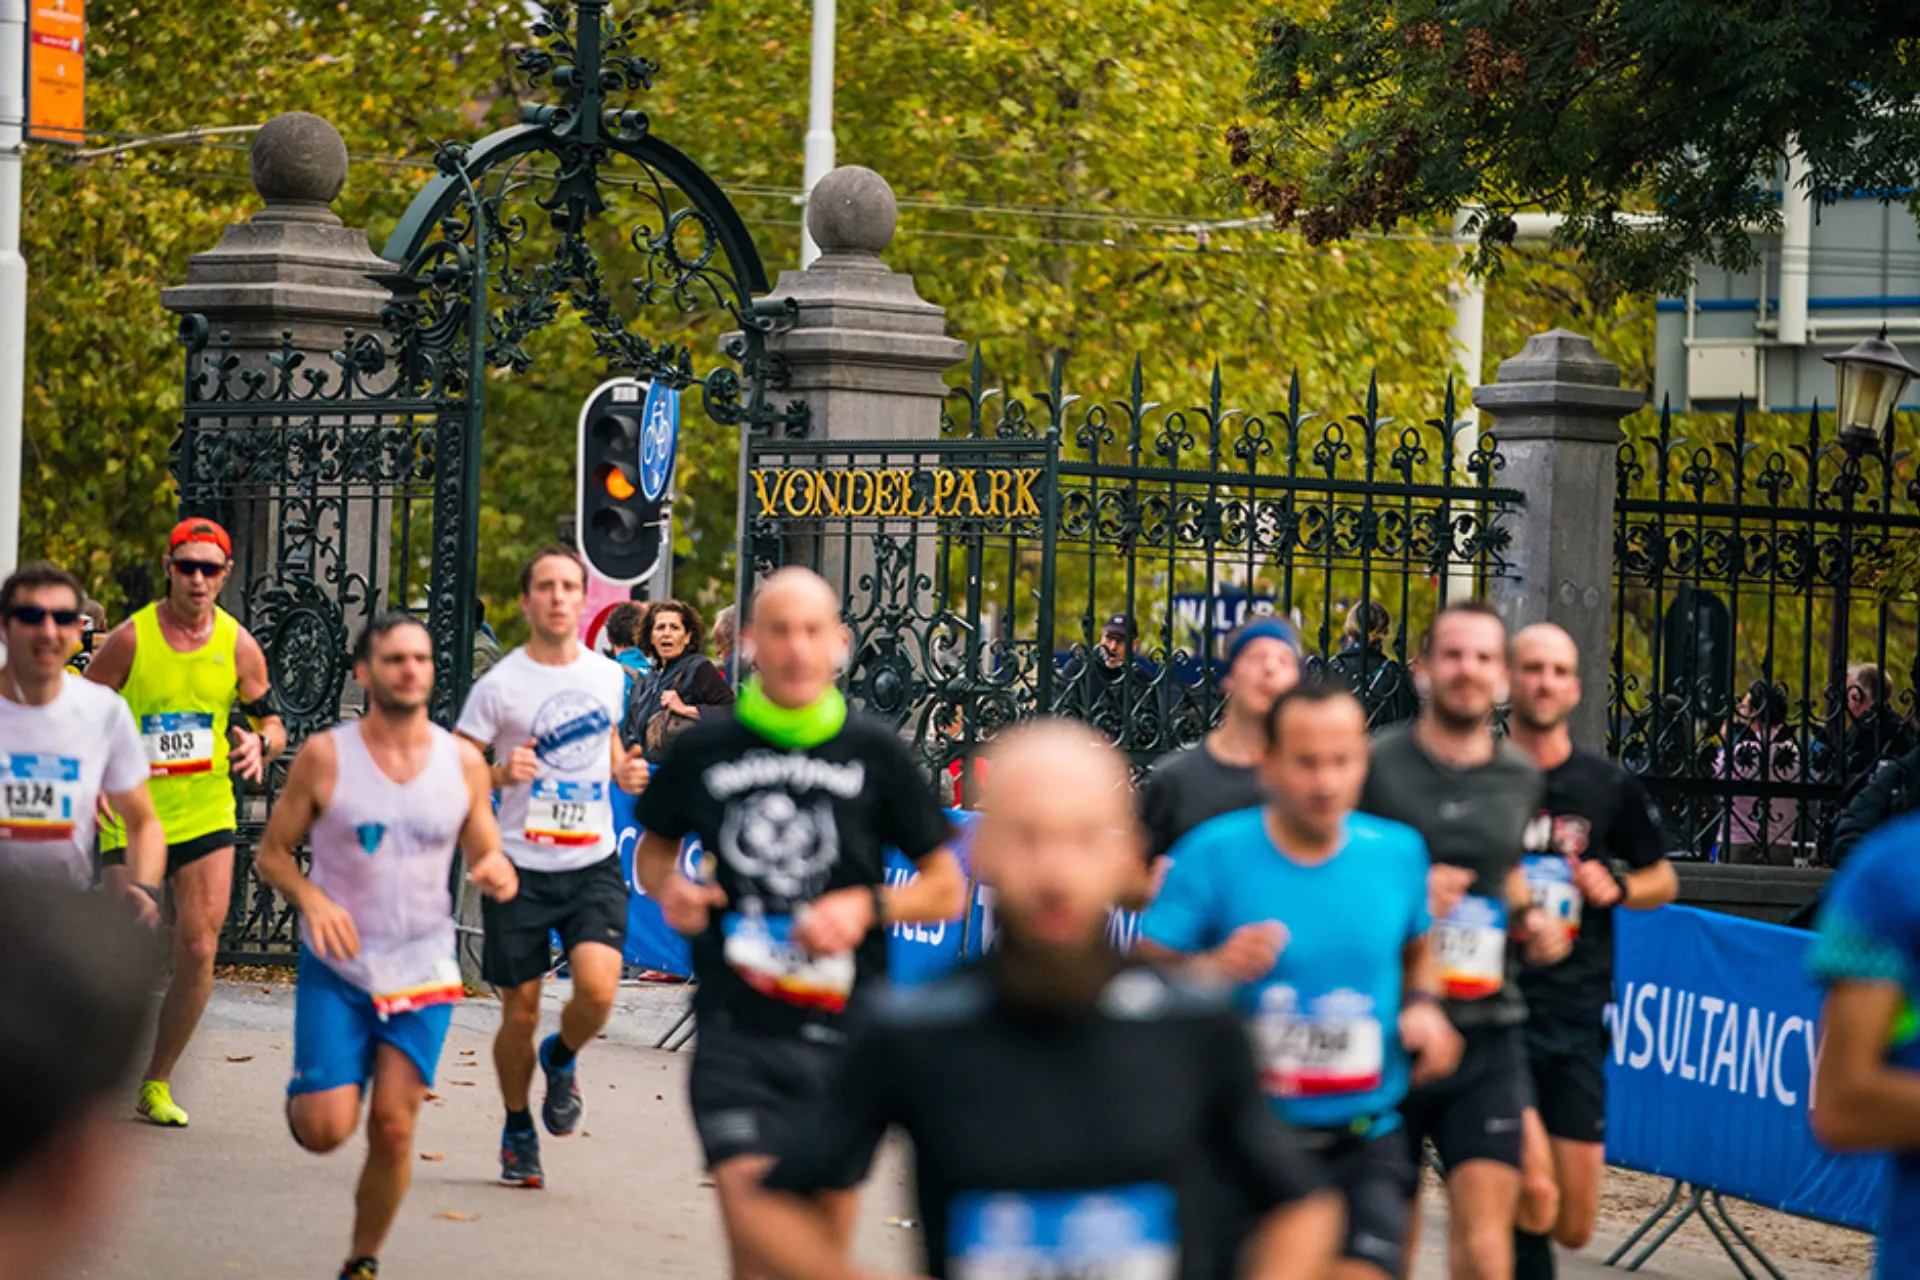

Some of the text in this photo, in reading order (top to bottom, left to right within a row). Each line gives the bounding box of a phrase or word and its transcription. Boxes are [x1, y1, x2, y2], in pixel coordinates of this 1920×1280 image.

[160, 732, 194, 752] 803
[5, 783, 53, 807] 1374
[552, 803, 586, 822] 1772
